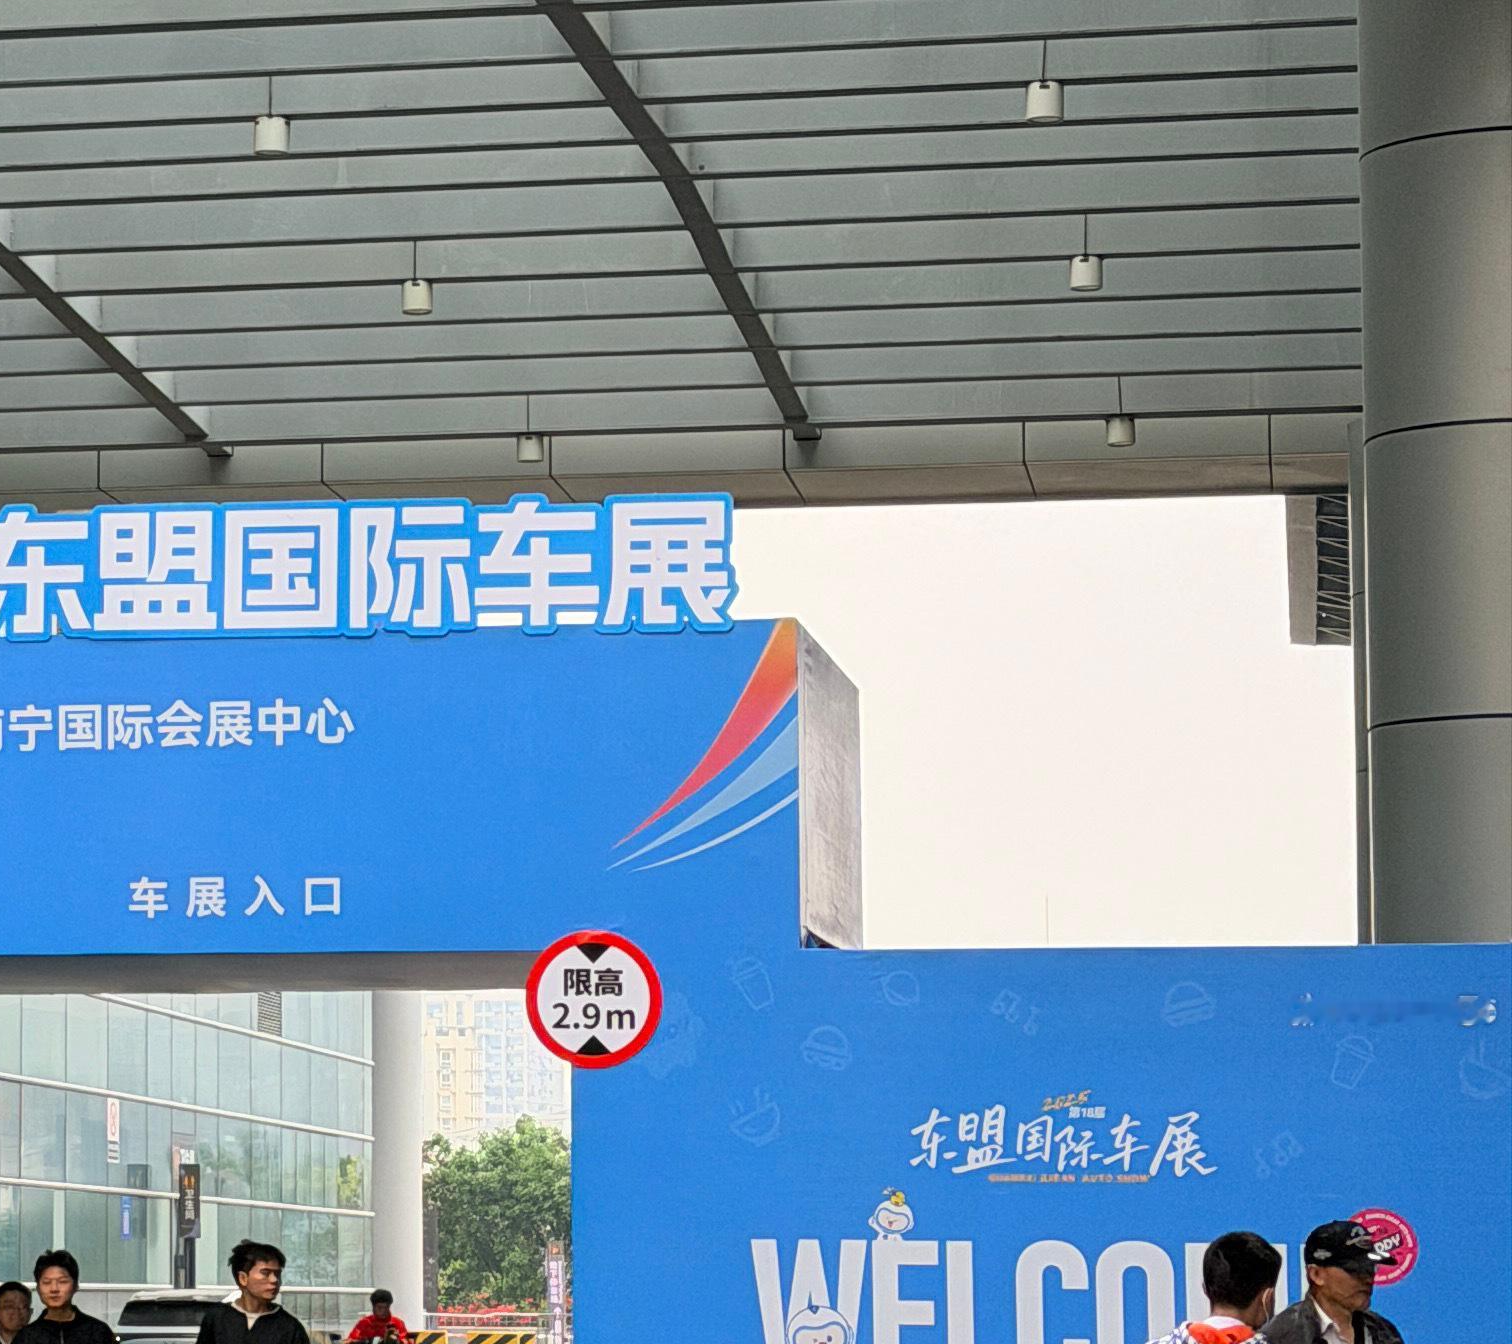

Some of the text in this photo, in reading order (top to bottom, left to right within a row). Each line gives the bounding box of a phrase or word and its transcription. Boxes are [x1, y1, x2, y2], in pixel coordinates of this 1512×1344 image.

[129, 875, 342, 918] 车展入口
[561, 967, 623, 999] 限高
[551, 1000, 637, 1031] 2.9m
[909, 1103, 1218, 1177] 东盟国际车展
